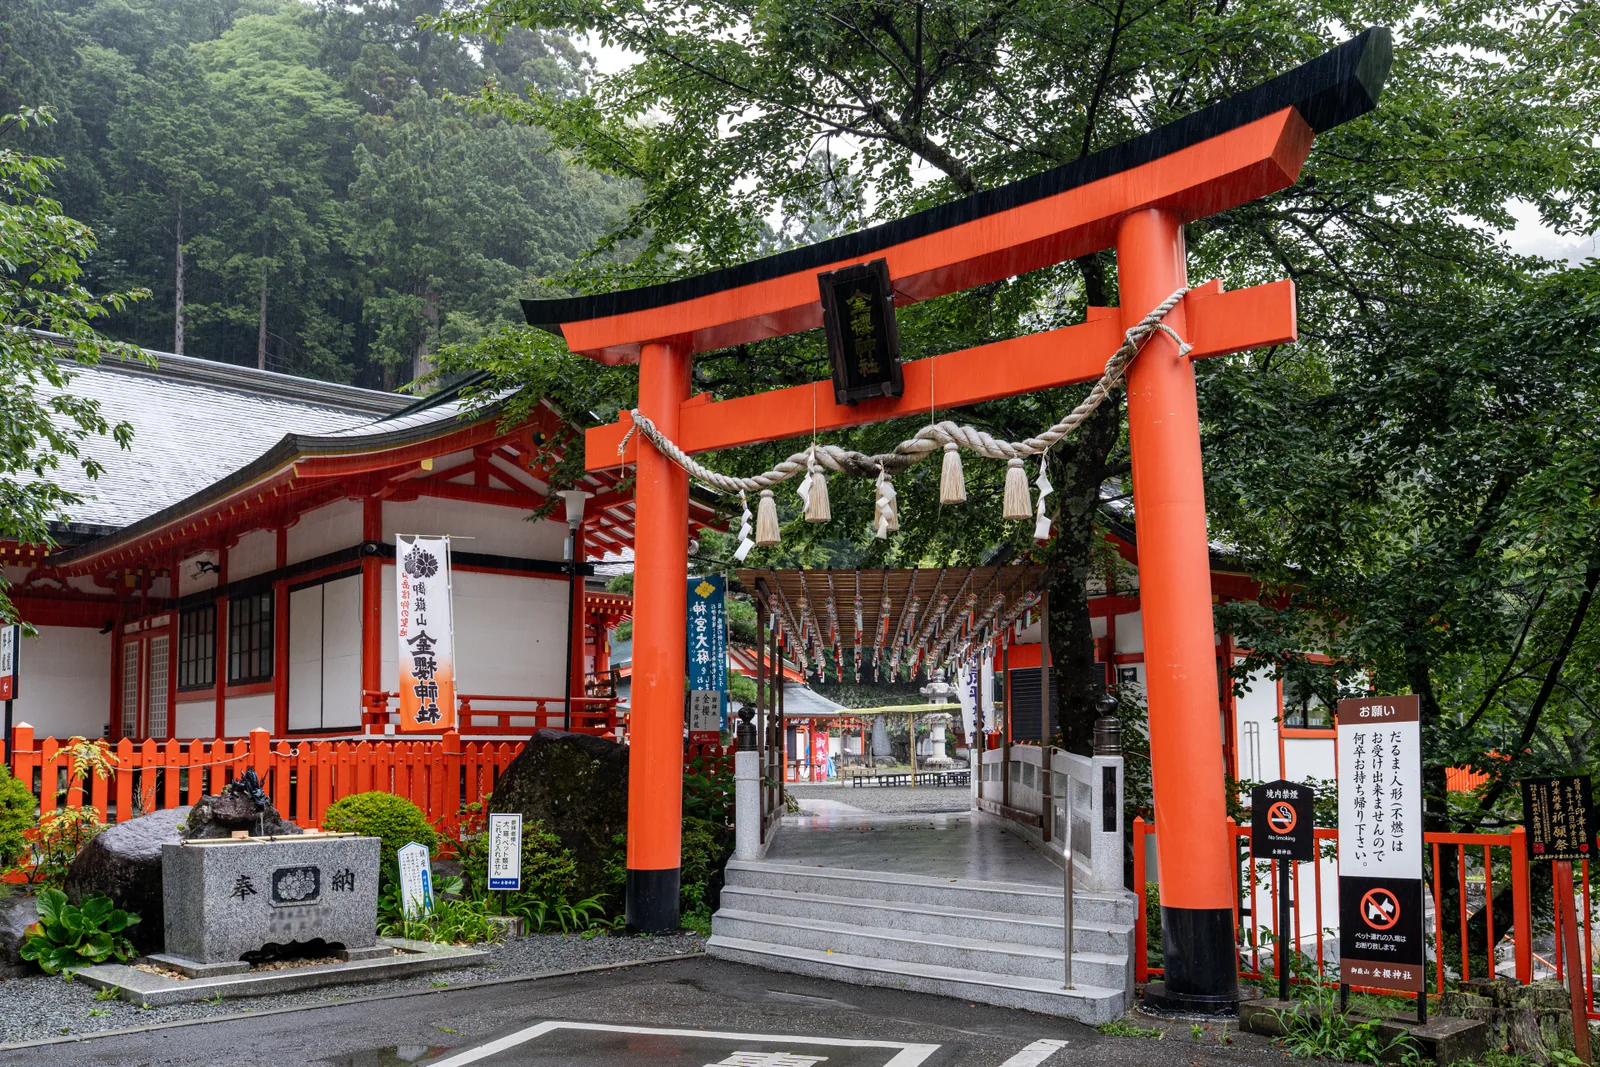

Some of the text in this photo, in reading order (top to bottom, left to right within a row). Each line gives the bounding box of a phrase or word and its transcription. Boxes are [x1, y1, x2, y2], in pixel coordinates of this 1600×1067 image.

[1359, 705, 1395, 718] お願い
[1265, 789, 1299, 799] 境内禁煙
[1352, 732, 1368, 867] 何卒お持ち帰り下さい。
[1371, 732, 1385, 862] お受け出来ませんので
[230, 869, 356, 901] 奉 納
[1372, 968, 1413, 980] 金櫻神社
